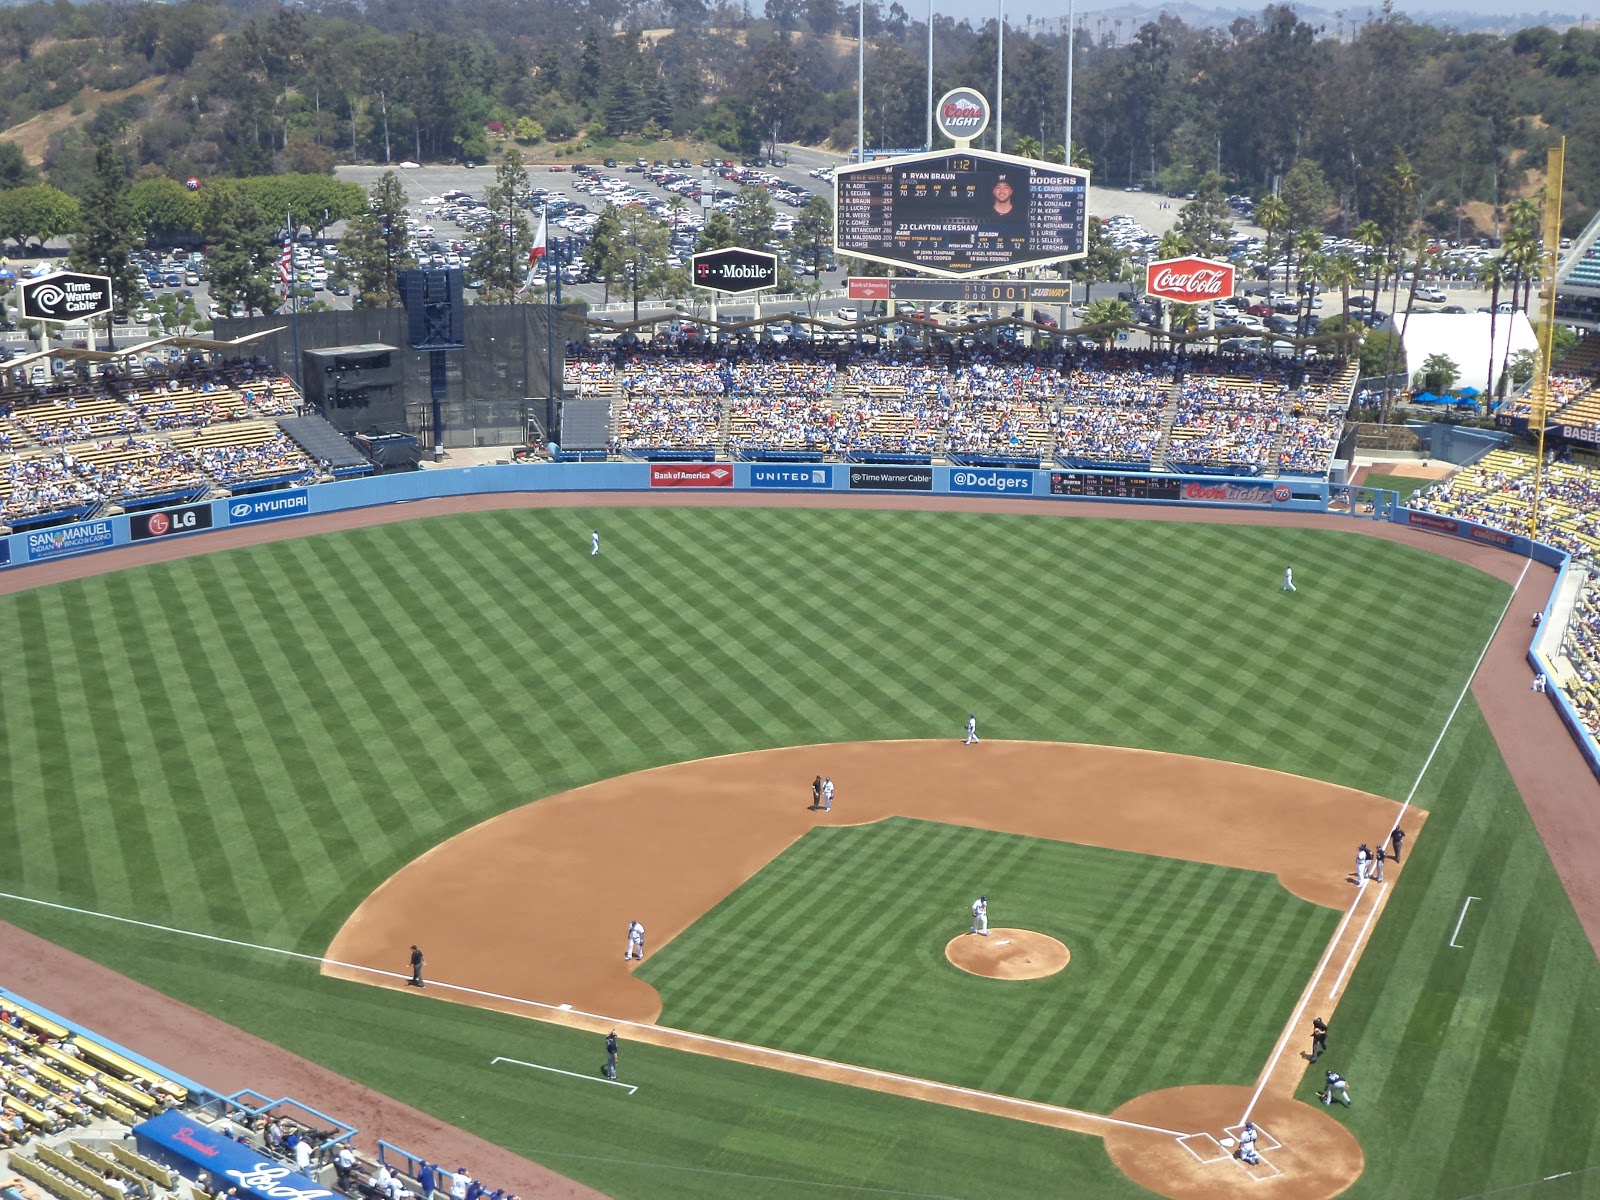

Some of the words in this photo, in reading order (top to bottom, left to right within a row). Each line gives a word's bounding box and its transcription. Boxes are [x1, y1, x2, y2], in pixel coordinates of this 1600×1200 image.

[944, 103, 983, 118] Coors
[954, 160, 970, 170] 1:12
[64, 282, 91, 291] Time
[65, 292, 103, 301] Warner
[992, 287, 1000, 299] 0
[1006, 287, 1014, 299] 0
[1021, 288, 1026, 299] 1
[1031, 288, 1069, 297] SUBWAY
[66, 302, 96, 312] Cable
[756, 472, 809, 481] UNITED
[908, 474, 929, 482] Cable
[954, 472, 1028, 490] @Dodgers
[1186, 483, 1227, 499] Coors
[1227, 490, 1266, 500] LIGHT
[1277, 489, 1288, 498] 76
[255, 496, 307, 513] HYUNDAI
[173, 511, 196, 529] LG
[30, 533, 53, 546] SAN
[63, 523, 110, 540] MANUEL
[1475, 530, 1496, 541] CHOCO
[32, 543, 54, 553] INDIAN
[64, 538, 84, 547] BINGO
[90, 533, 111, 542] CASINO
